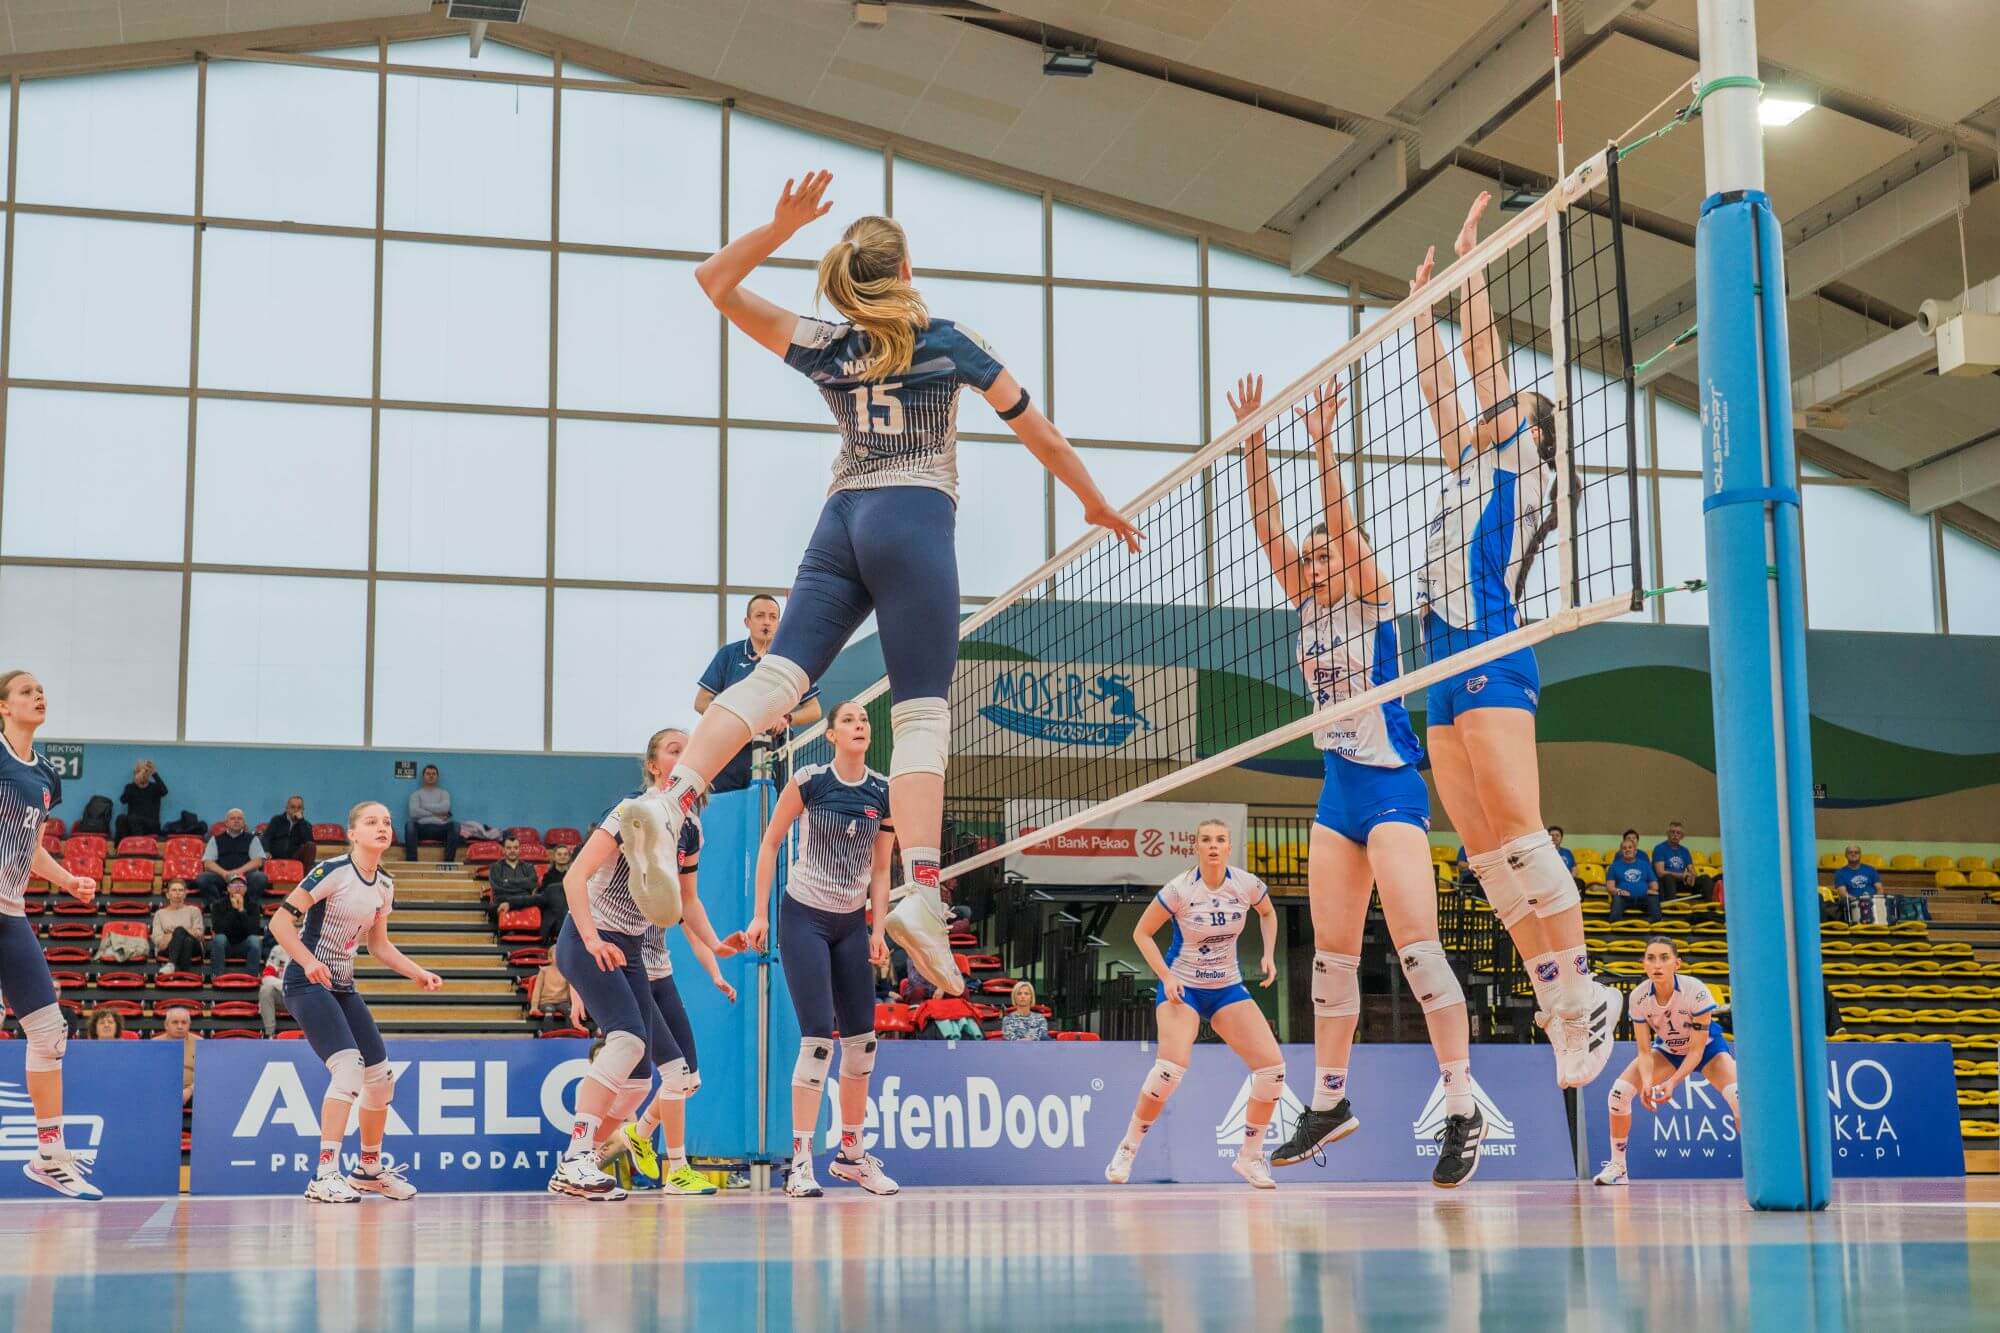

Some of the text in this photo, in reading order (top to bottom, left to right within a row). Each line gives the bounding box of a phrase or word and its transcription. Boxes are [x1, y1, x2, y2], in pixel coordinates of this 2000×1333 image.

[848, 383, 904, 435] 15
[47, 744, 82, 753] SEKTOR
[847, 820, 857, 837] 4
[1057, 836, 1089, 849] Bank
[1091, 836, 1130, 850] Pekao
[1169, 832, 1197, 846] 1 Lig
[1209, 912, 1226, 926] 18
[1667, 1020, 1677, 1032] 1
[414, 1151, 421, 1170] I
